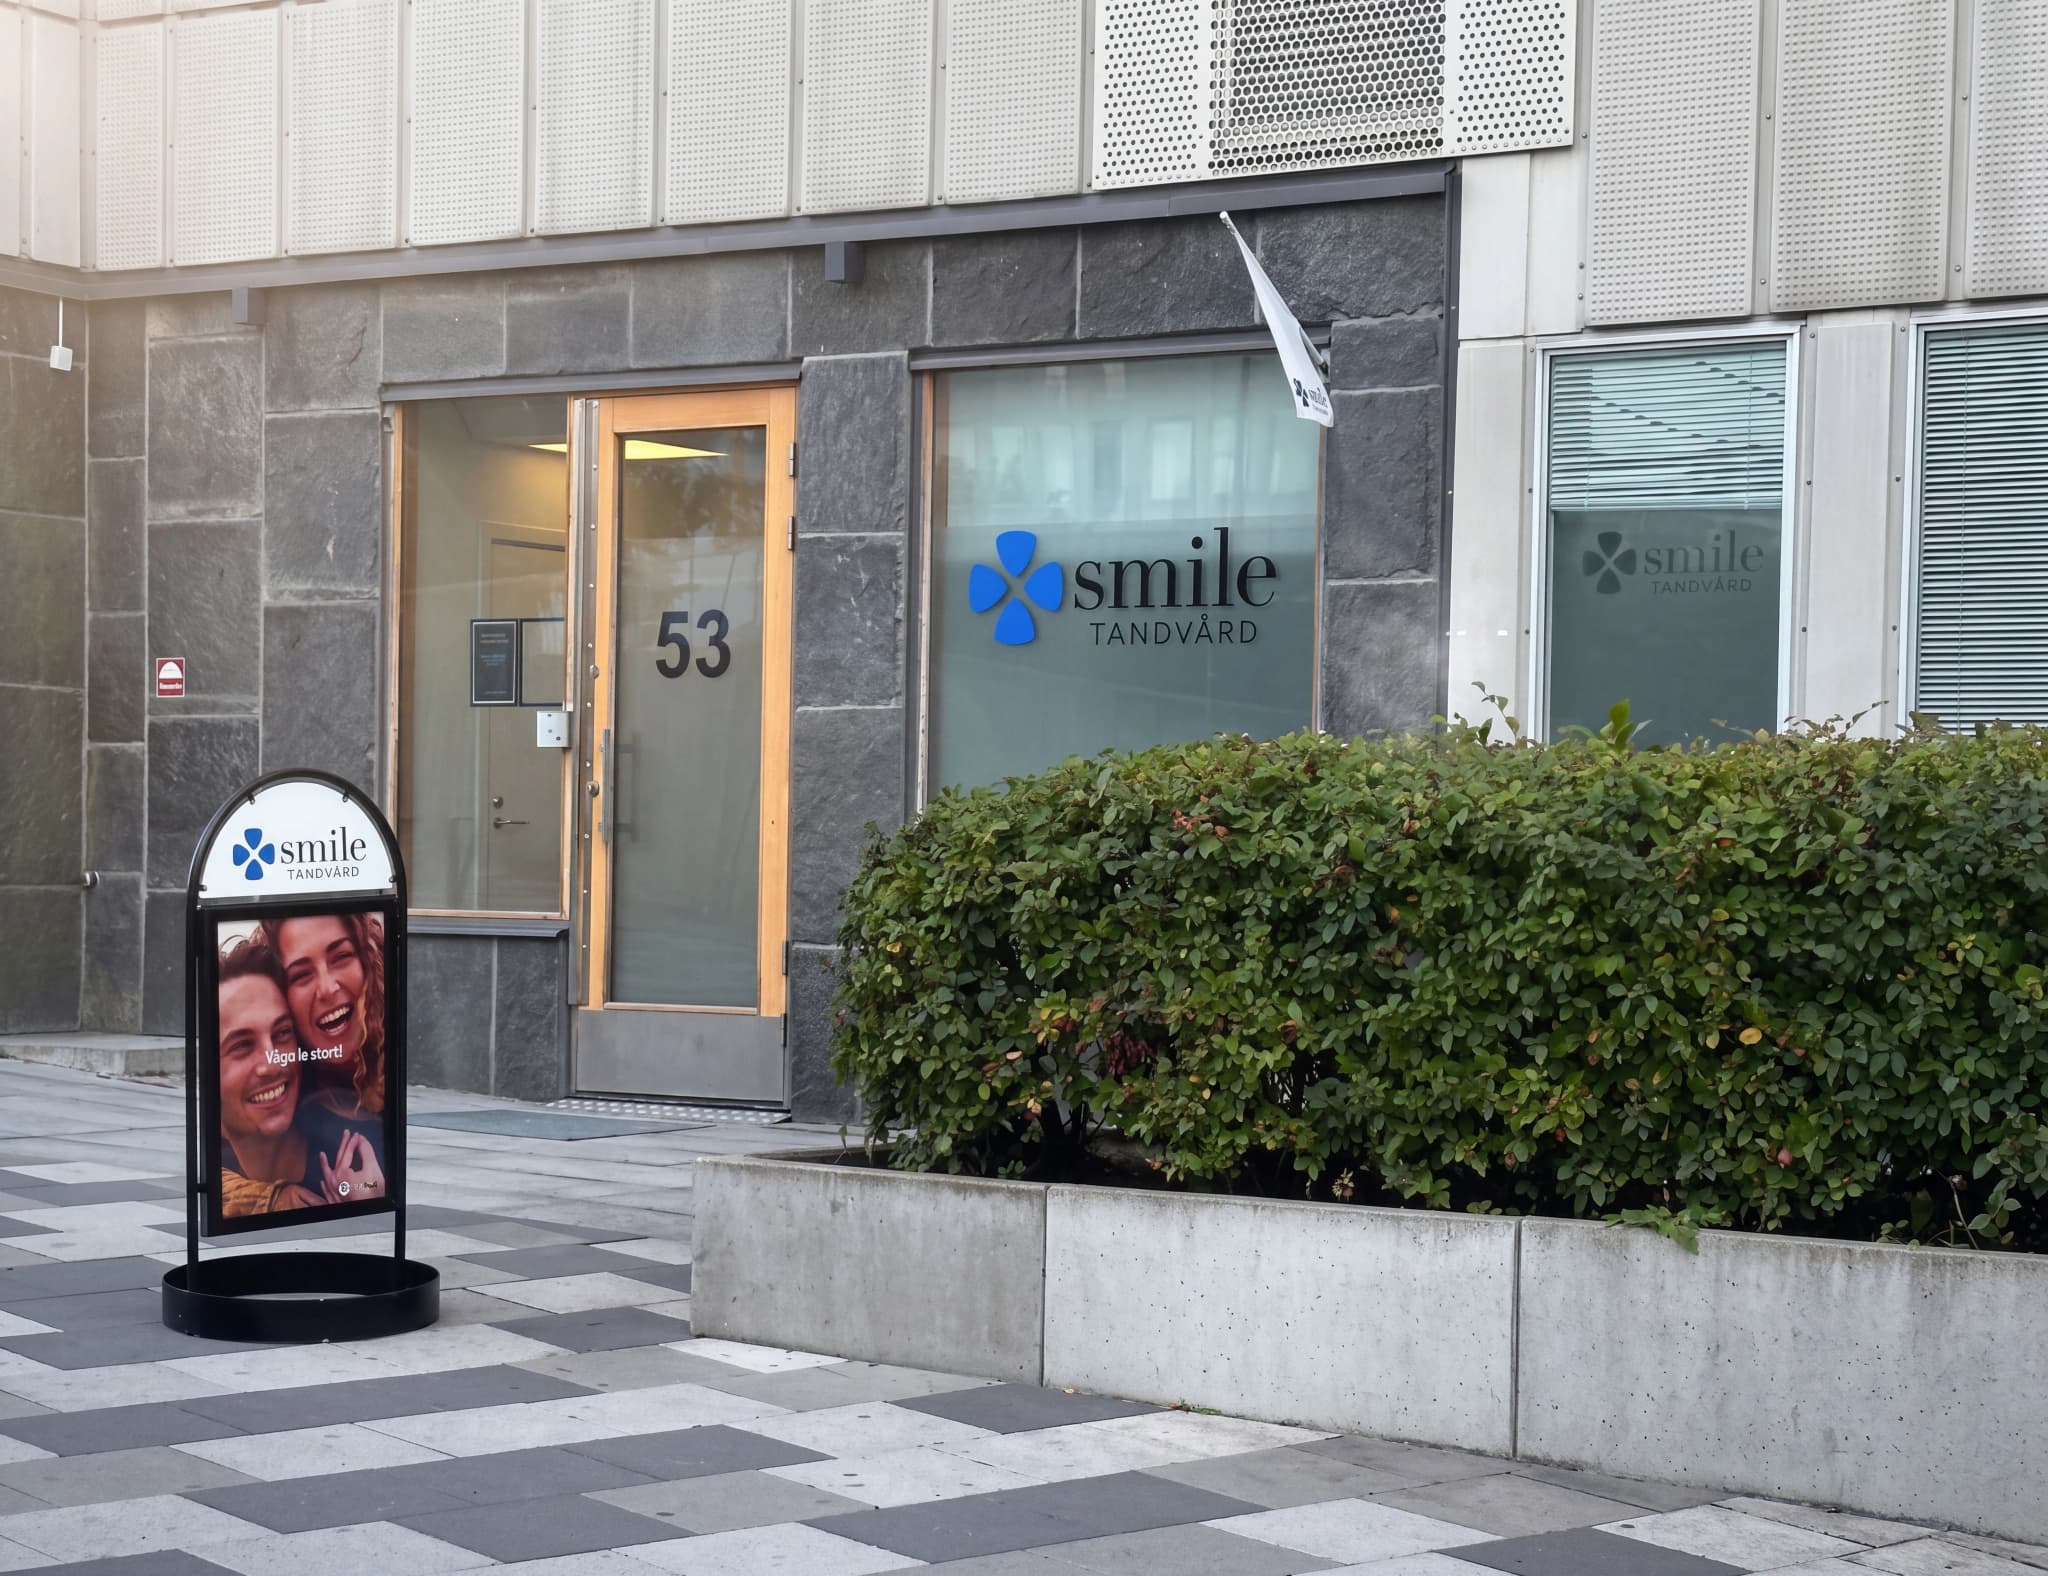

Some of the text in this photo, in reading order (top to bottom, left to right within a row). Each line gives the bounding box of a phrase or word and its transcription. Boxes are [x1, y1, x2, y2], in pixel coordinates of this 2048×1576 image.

[1074, 527, 1277, 611] smile
[1644, 528, 1764, 575] smile
[1649, 575, 1753, 593] TANDVÅRD
[656, 609, 731, 678] 53
[1089, 613, 1257, 646] TANDVÅRD
[280, 826, 367, 864] smile
[287, 865, 360, 881] TANDVÅRD
[265, 1043, 343, 1067] Våga le stort!
